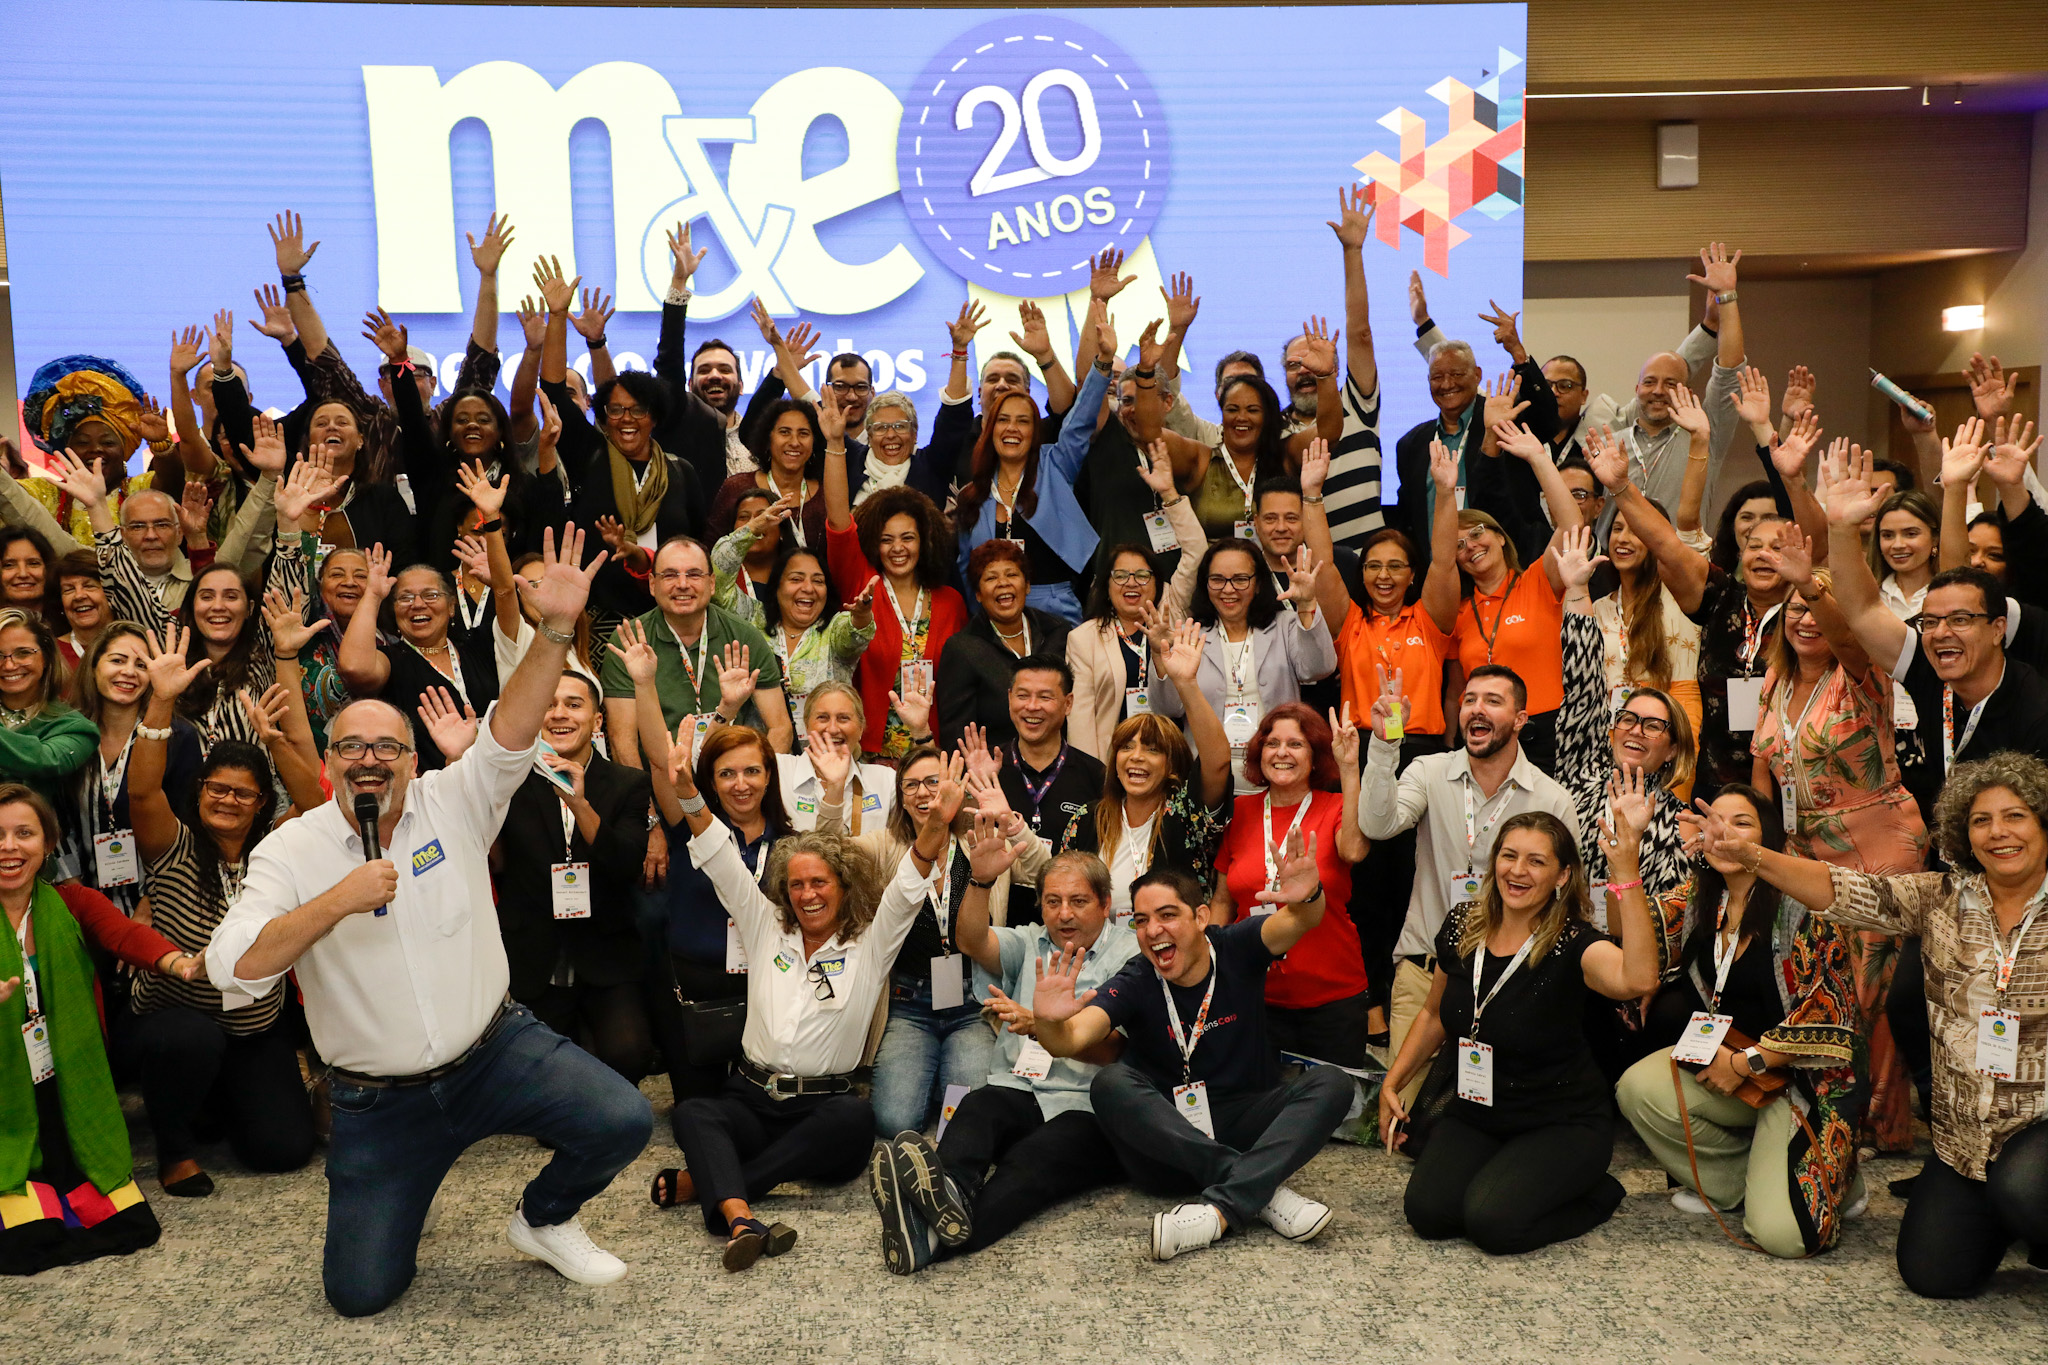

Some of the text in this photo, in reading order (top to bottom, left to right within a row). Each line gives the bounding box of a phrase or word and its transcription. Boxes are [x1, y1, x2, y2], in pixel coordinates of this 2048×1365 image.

[955, 68, 1102, 197] 20
[361, 60, 926, 323] m&e
[987, 186, 1116, 251] ANOS
[1504, 614, 1526, 626] GOL
